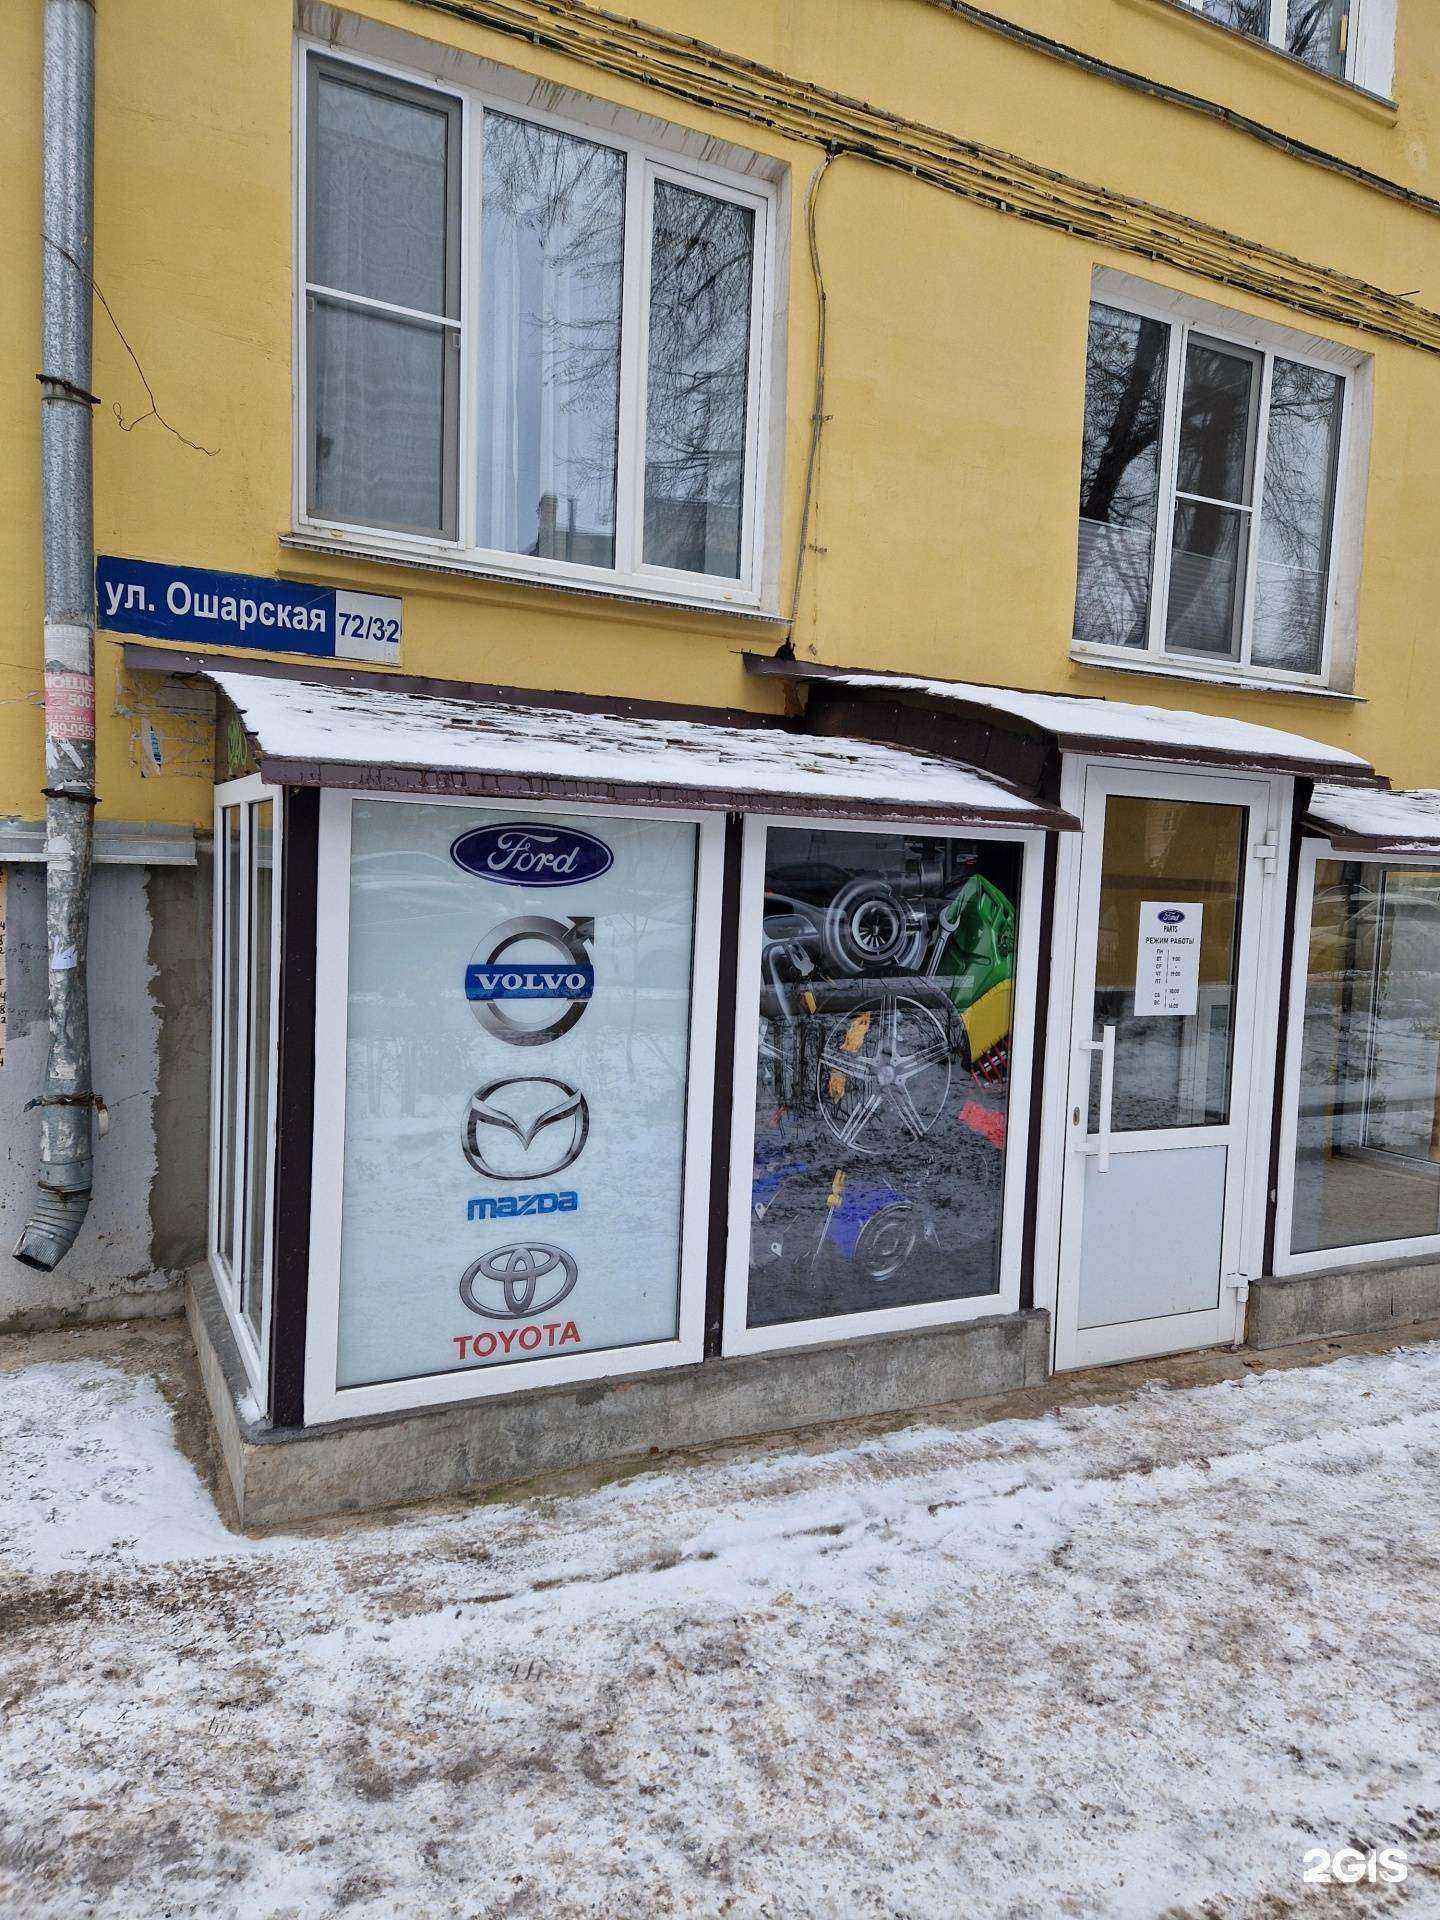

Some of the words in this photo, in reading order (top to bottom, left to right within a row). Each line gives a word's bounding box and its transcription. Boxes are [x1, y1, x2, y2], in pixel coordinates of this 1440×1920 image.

[105, 580, 155, 616] ул.
[166, 581, 326, 633] Ошарская
[338, 611, 400, 644] 72/32
[487, 832, 580, 873] Ford
[1145, 936, 1169, 945] РЕЖИМ
[1170, 937, 1195, 945] РАБОТЫ
[1163, 925, 1178, 933] PARTS
[475, 973, 586, 990] VOLVO
[453, 1321, 581, 1360] TOYOTA
